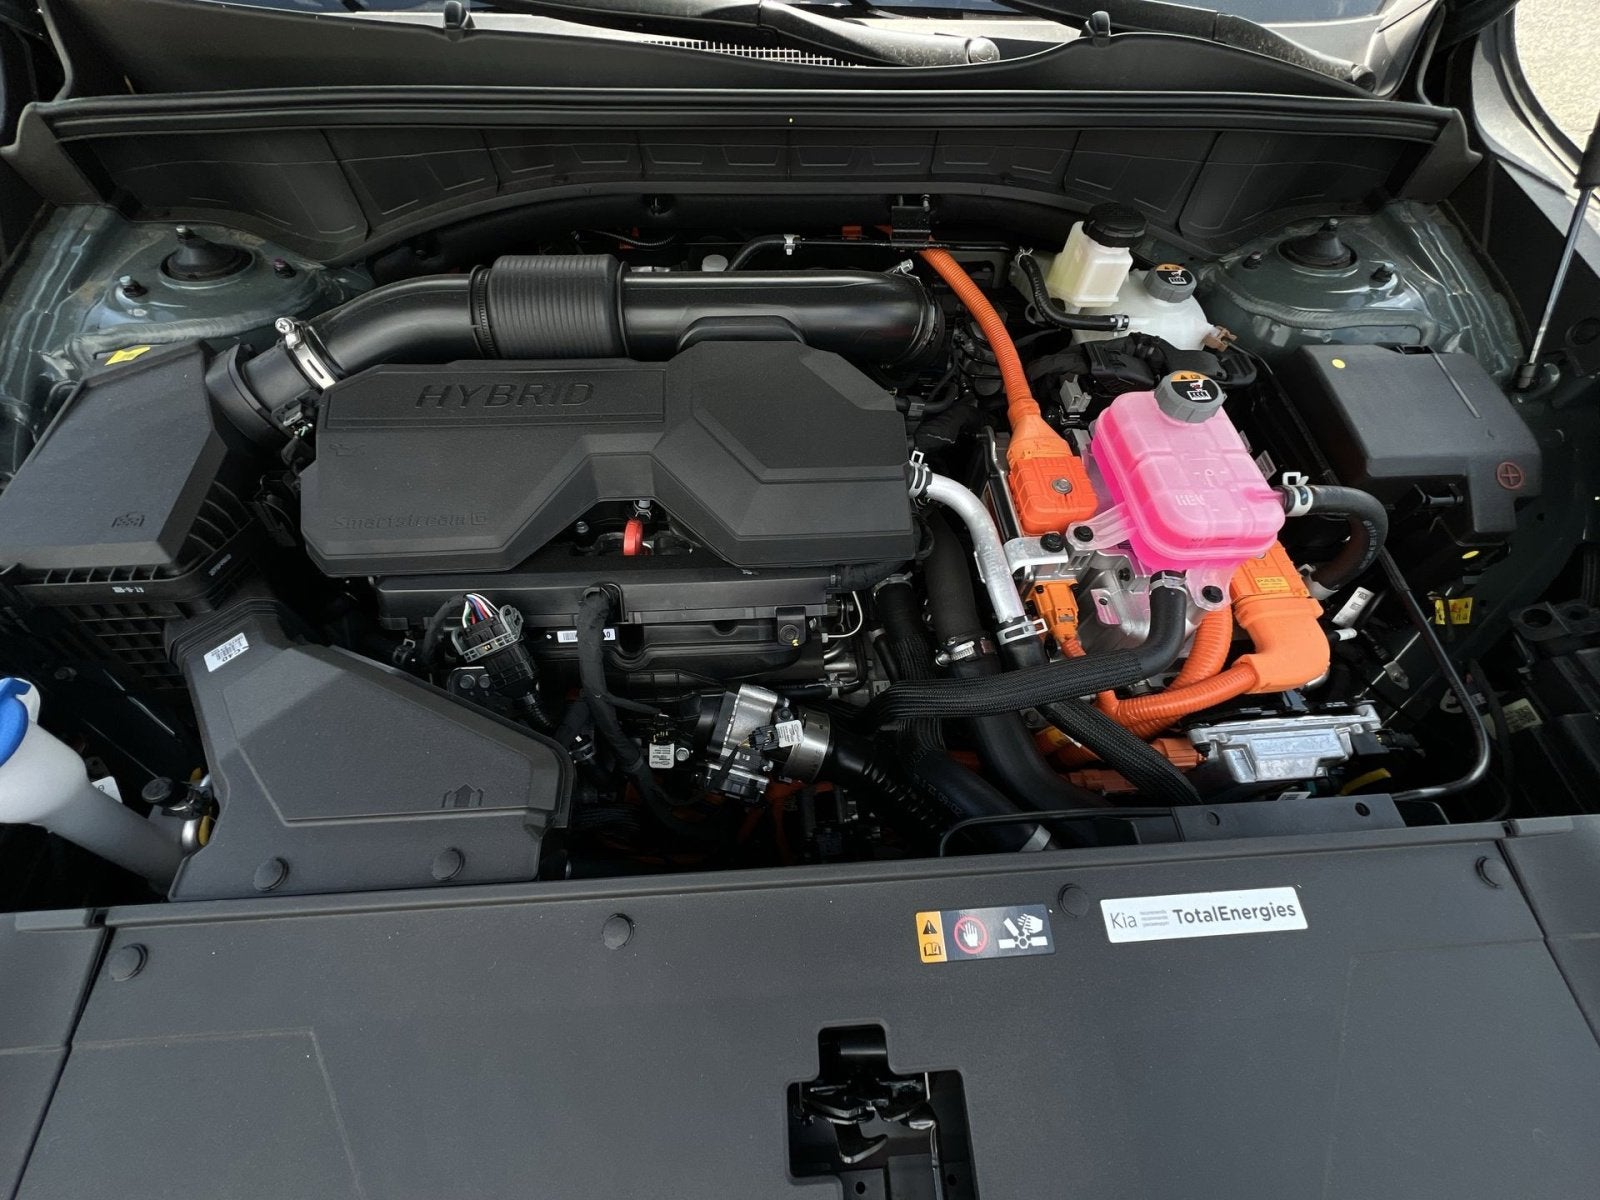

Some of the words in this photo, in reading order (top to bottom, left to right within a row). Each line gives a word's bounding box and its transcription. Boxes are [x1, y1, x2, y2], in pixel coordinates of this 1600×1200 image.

[415, 383, 594, 409] HYBRID
[335, 513, 465, 529] Smartstream
[1109, 911, 1138, 929] Kia
[1172, 902, 1296, 925] TotalEnergies
